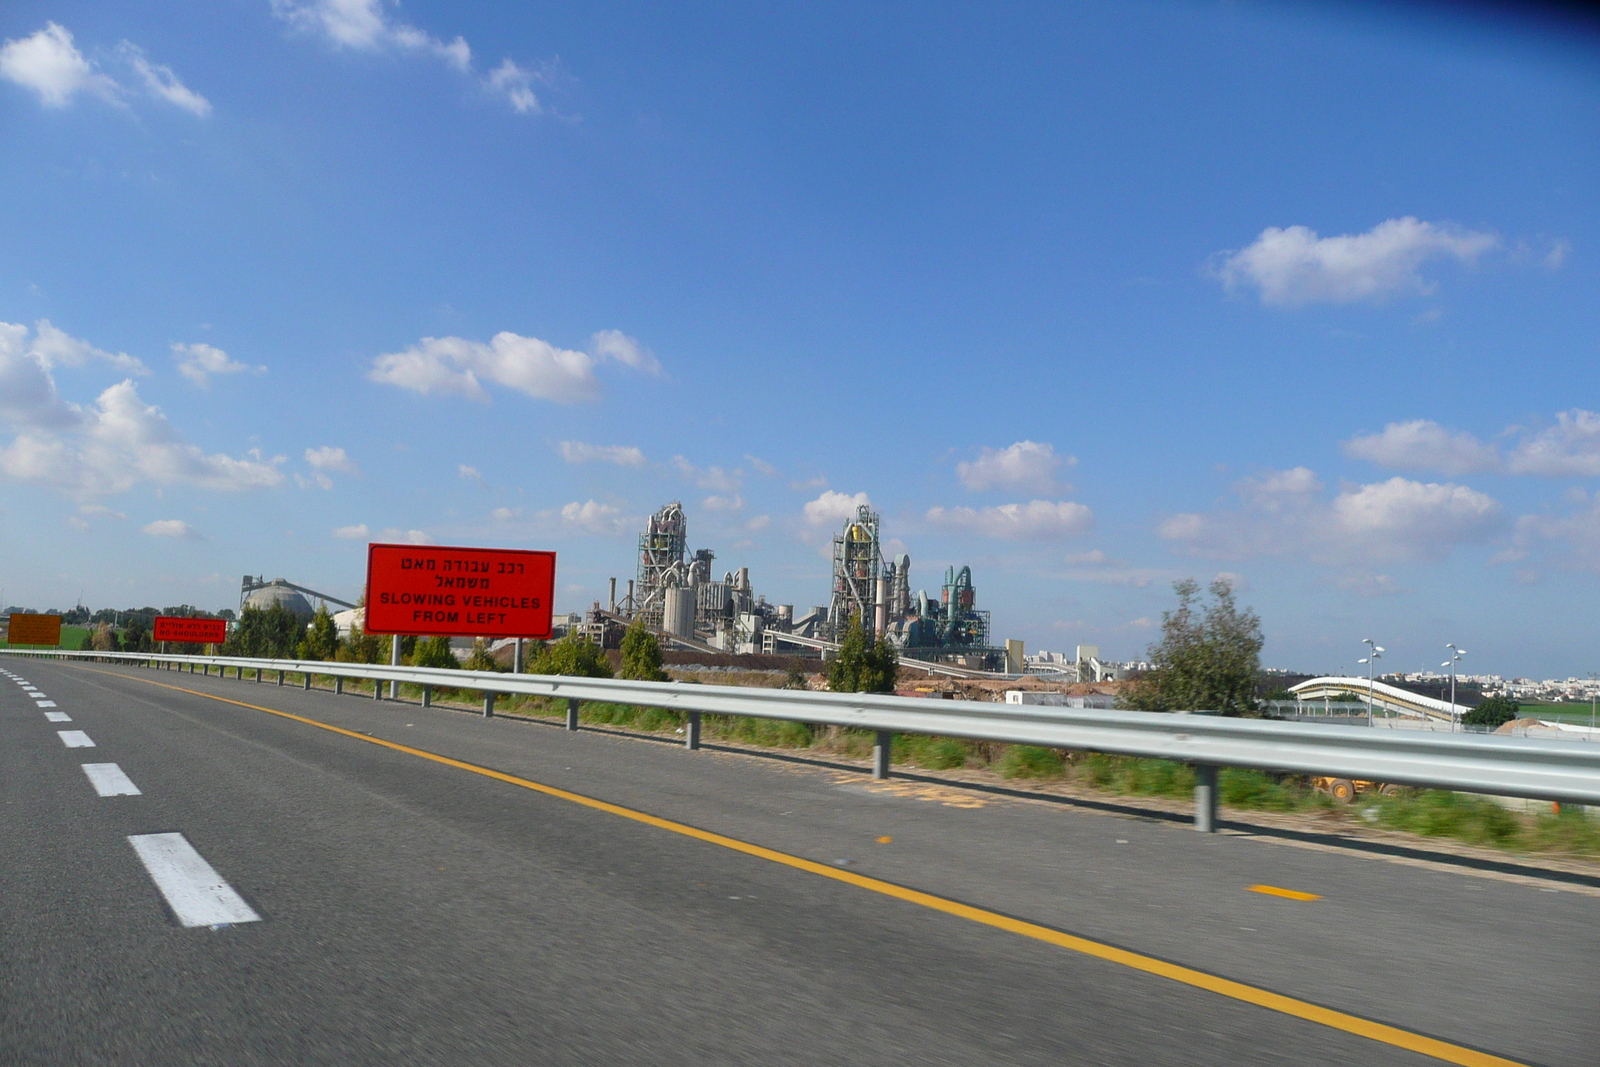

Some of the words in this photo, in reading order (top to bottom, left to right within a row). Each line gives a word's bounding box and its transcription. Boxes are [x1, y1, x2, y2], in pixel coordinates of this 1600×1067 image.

[401, 558, 436, 571] מאט
[443, 559, 490, 572] עבודה
[497, 562, 525, 575] רכב
[435, 575, 490, 589] משמאל
[380, 592, 456, 606] SLOWING
[462, 595, 541, 609] VEHICLES
[413, 610, 459, 623] FROM
[467, 612, 507, 625] LEFT
